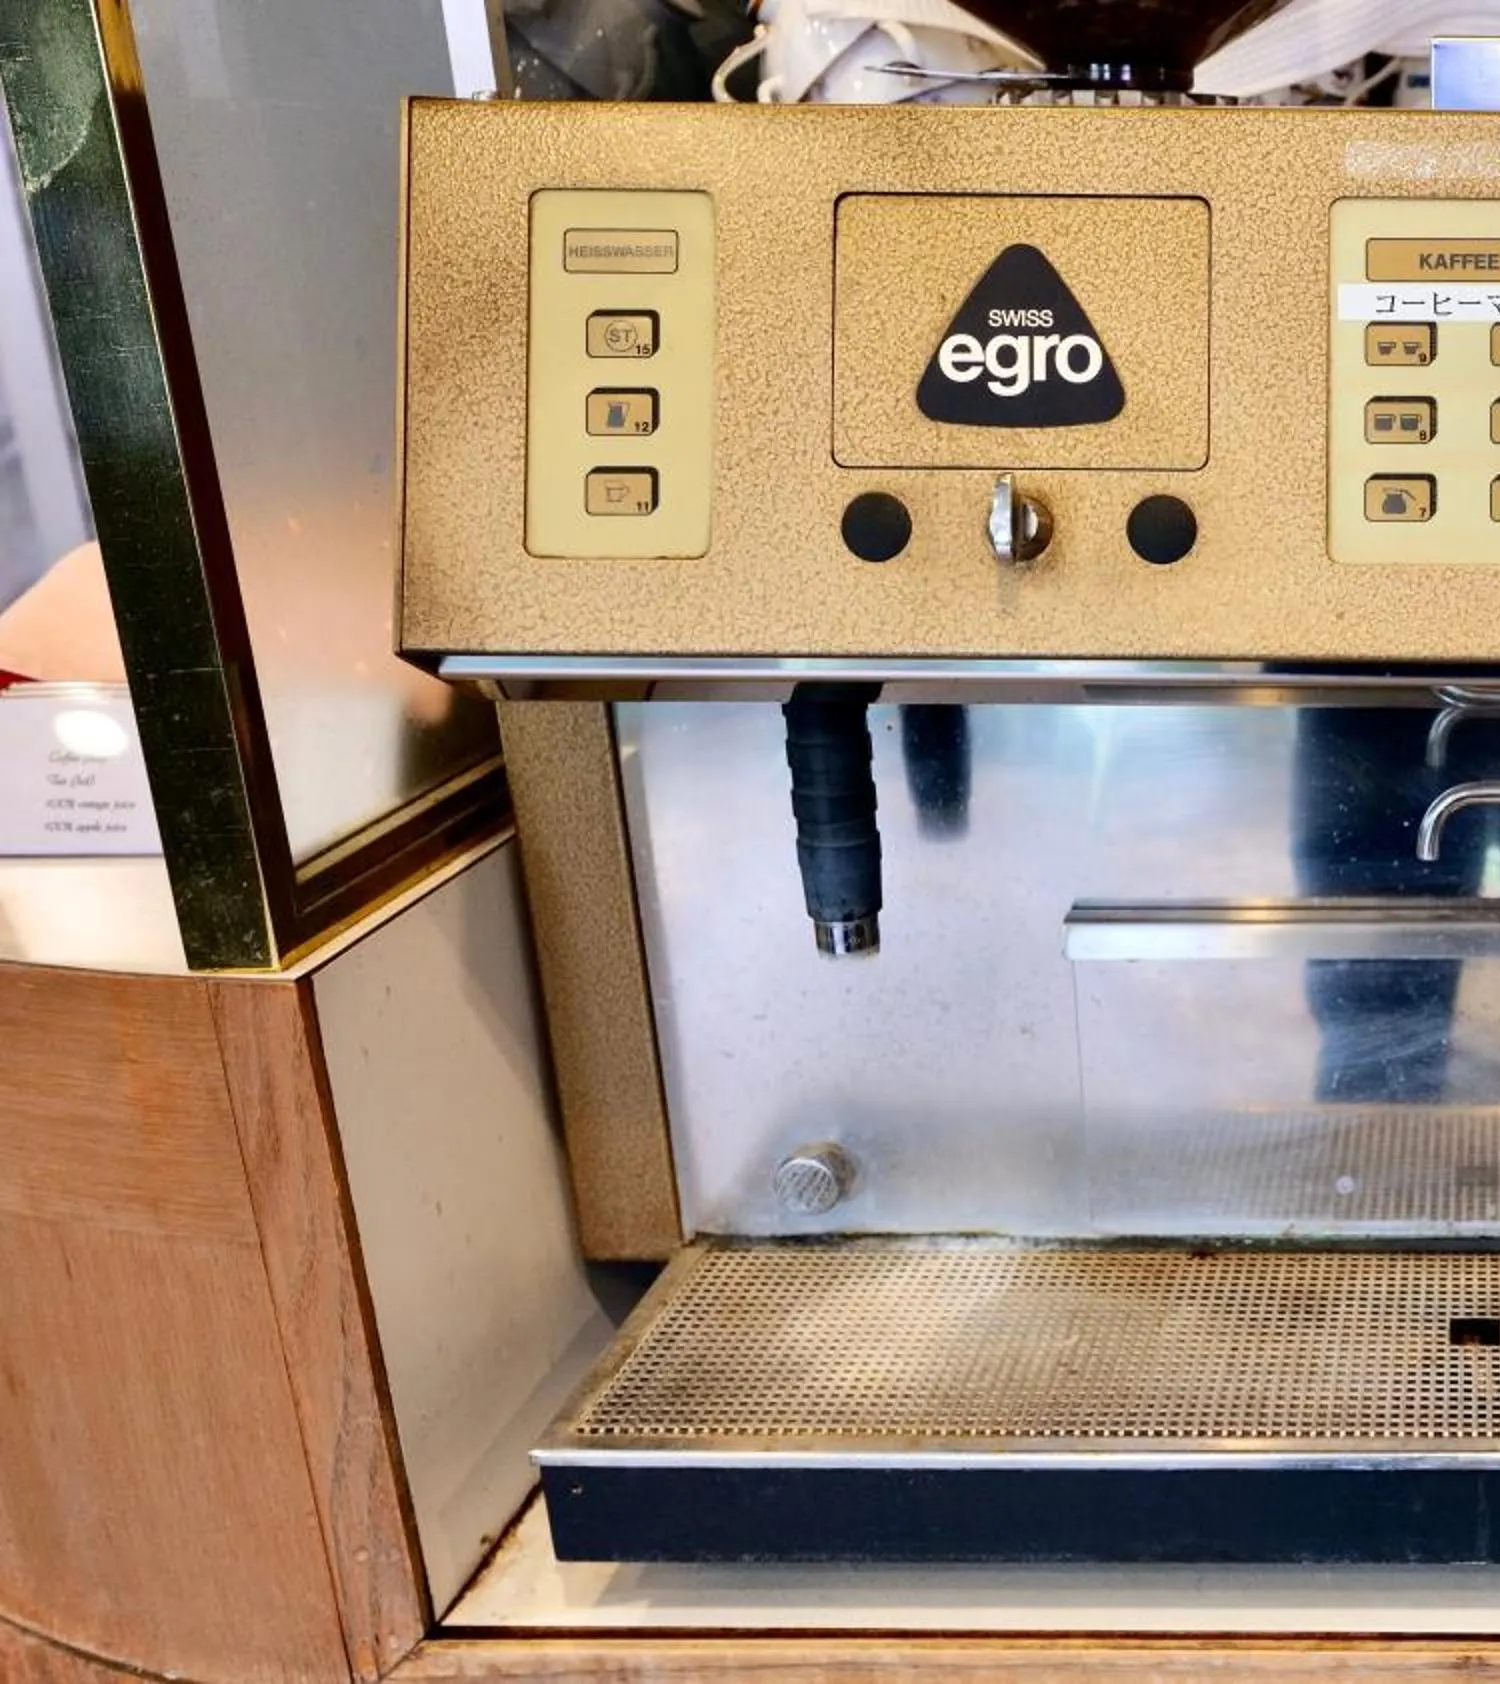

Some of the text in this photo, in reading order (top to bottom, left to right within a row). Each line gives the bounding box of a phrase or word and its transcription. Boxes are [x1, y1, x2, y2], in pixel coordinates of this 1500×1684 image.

[568, 245, 674, 258] HEISSWASSER
[1419, 253, 1500, 270] KAFFEE
[987, 308, 1055, 328] SWISS
[608, 328, 633, 343] ST
[636, 343, 651, 355] 15
[938, 333, 1104, 397] egro
[634, 420, 650, 432] 12
[637, 501, 649, 512] 11
[1418, 507, 1427, 518] 7
